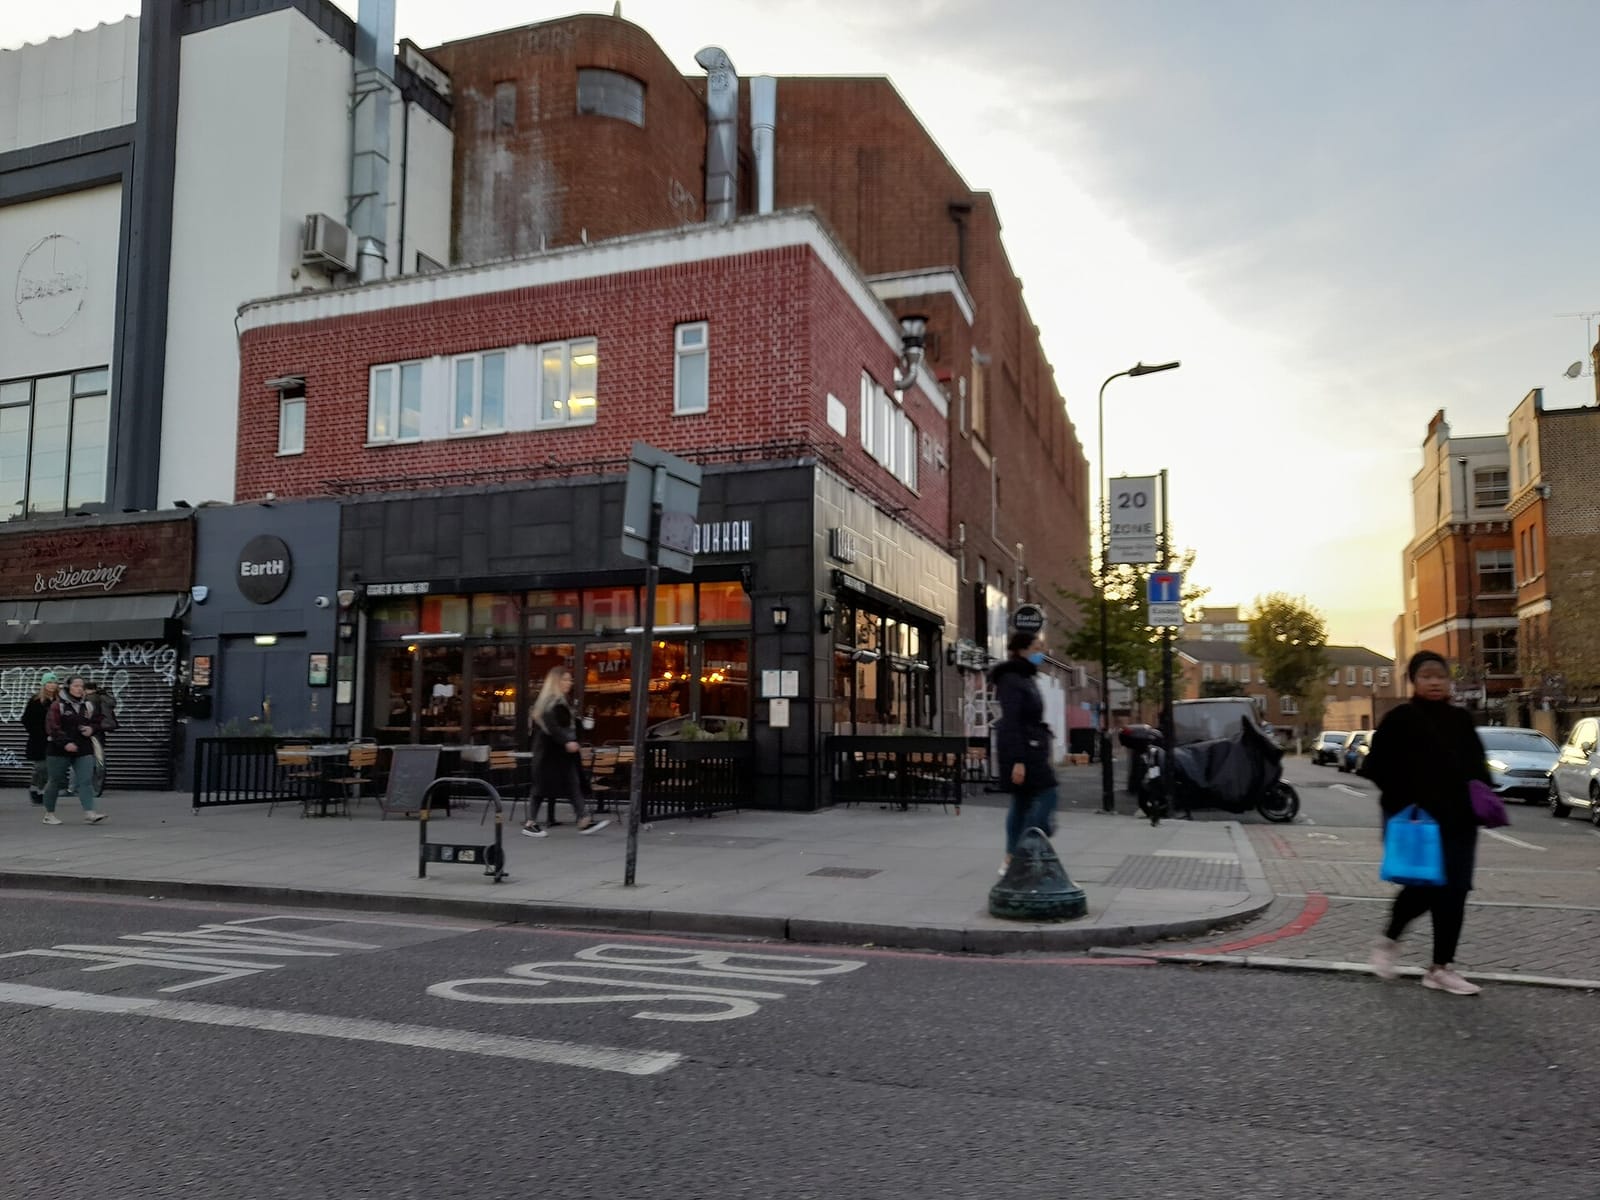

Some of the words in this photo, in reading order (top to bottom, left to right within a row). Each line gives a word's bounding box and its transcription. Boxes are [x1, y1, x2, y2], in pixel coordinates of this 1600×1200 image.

[1118, 492, 1148, 509] 20
[693, 520, 749, 553] DUKKAH
[1113, 523, 1152, 534] ZONE
[34, 574, 48, 592] &
[48, 562, 127, 590] Piercing
[240, 559, 284, 576] EartH
[425, 943, 868, 1022] BUS
